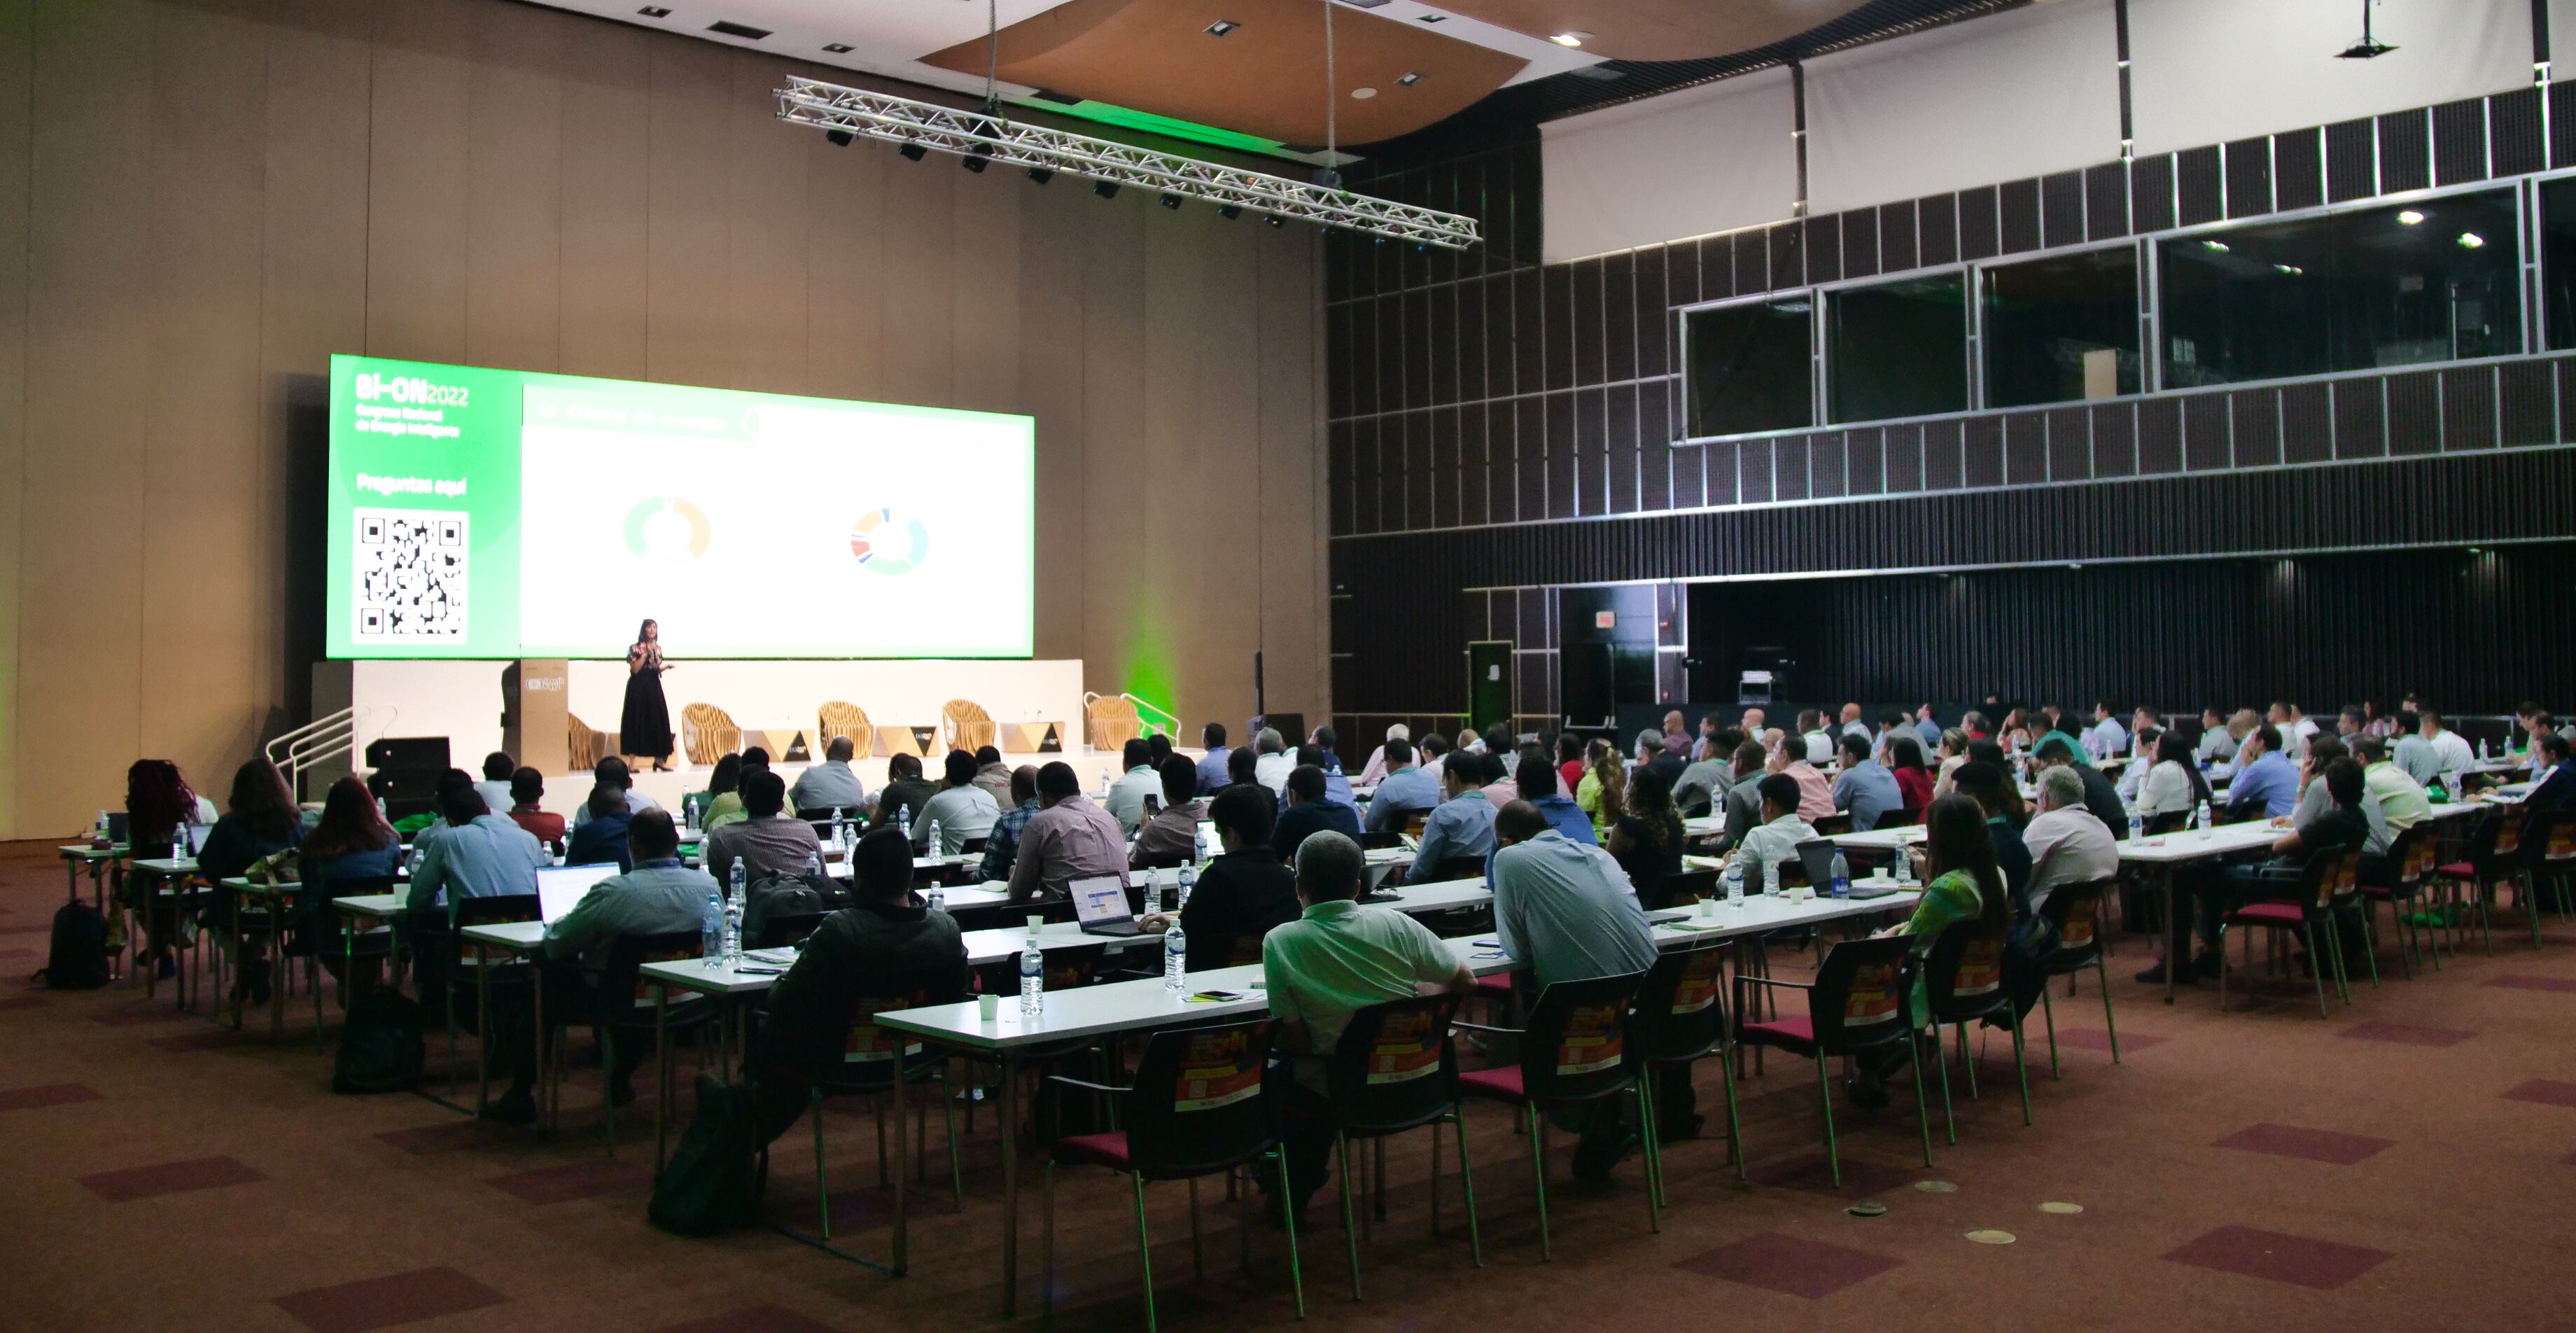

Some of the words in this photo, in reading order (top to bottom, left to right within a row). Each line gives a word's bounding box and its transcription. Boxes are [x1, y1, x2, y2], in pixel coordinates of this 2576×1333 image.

[356, 419, 370, 431] de
[356, 473, 432, 496] Preguntas
[434, 477, 467, 498] aquí
